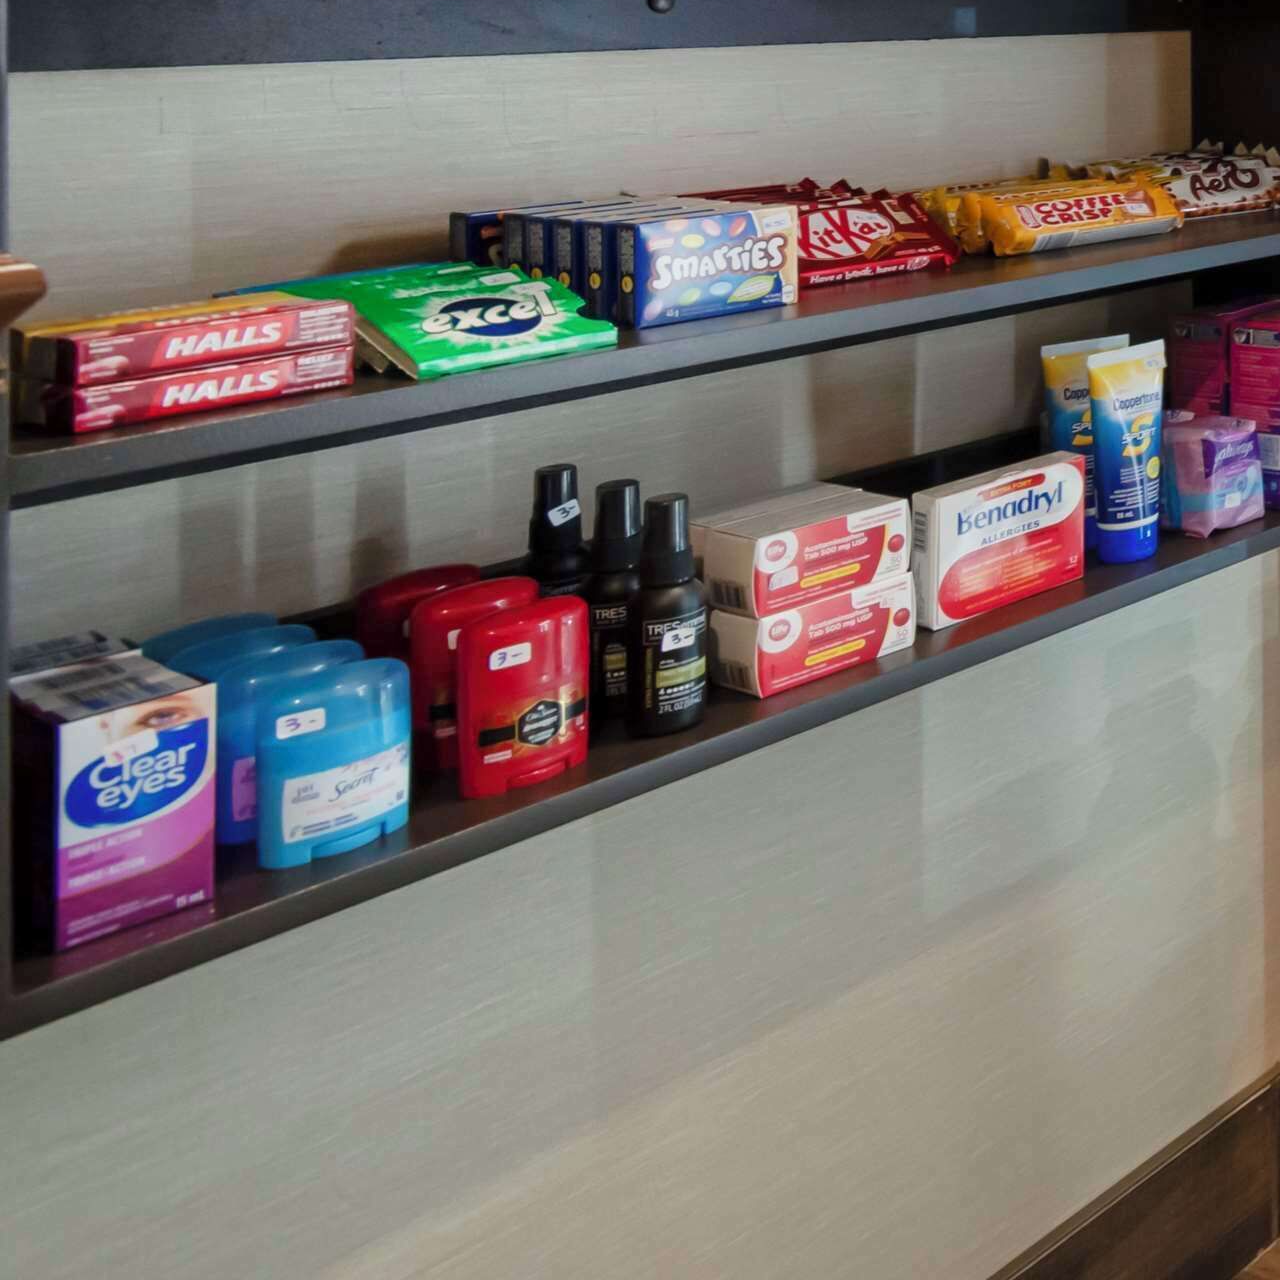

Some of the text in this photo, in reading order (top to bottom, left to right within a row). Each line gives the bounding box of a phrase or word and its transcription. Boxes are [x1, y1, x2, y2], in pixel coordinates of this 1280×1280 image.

[1034, 193, 1126, 216] COFFEE
[1040, 206, 1114, 227] CRISP
[165, 320, 282, 360] HALLS
[162, 369, 279, 407] HALLS
[956, 480, 1064, 536] Benadryl
[981, 519, 1040, 545] ALLERGIES
[88, 742, 196, 790] Clear
[328, 767, 379, 802] Secret
[95, 767, 186, 809] eyes
